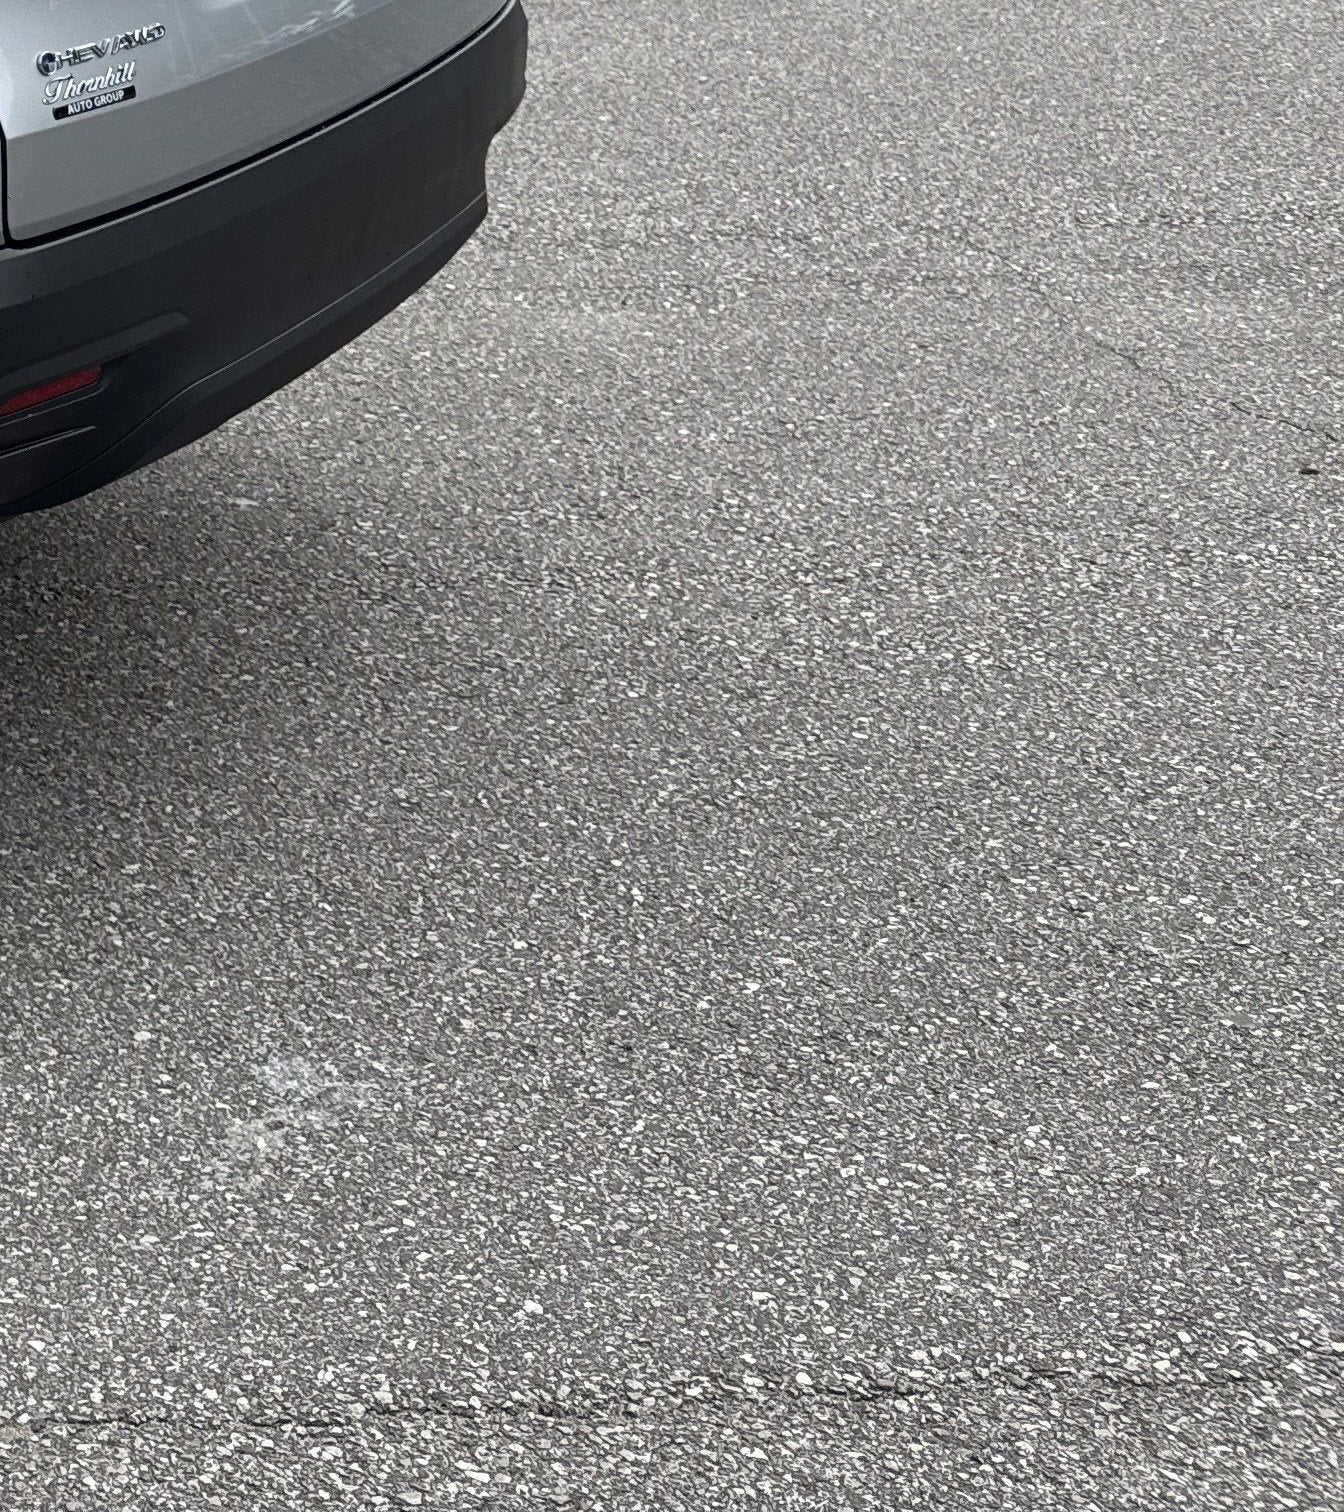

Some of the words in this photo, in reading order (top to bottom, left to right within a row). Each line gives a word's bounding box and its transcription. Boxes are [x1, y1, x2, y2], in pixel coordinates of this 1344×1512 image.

[42, 60, 136, 105] Thornhill
[67, 99, 93, 115] AUTO
[93, 89, 125, 107] GROUP
